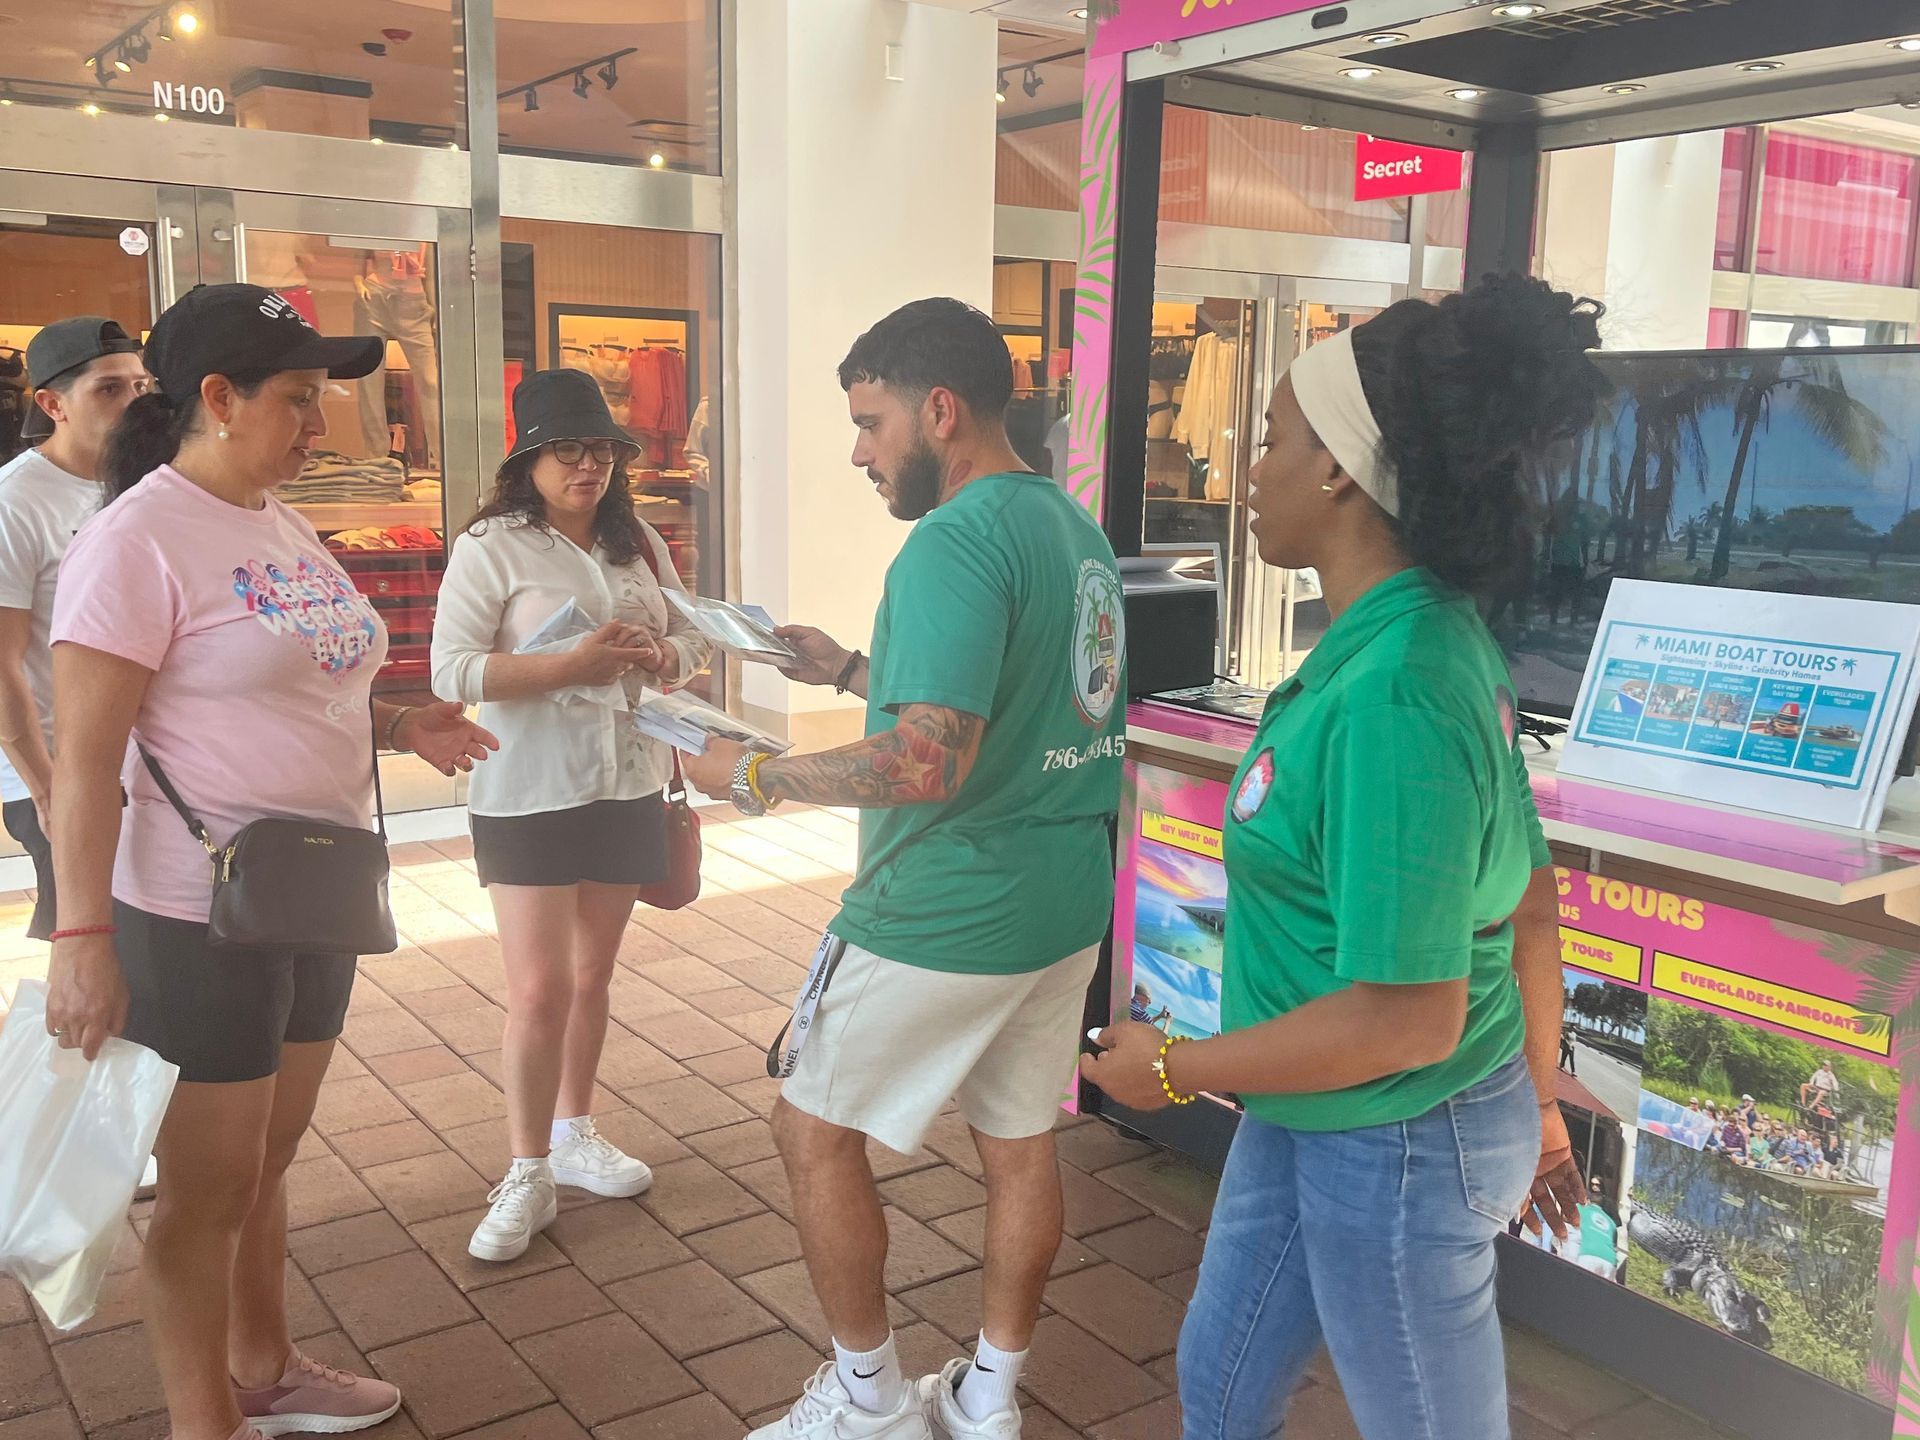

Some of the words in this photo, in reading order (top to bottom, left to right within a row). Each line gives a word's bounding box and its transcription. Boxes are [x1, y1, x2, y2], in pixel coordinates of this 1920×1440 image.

[153, 80, 225, 115] N100
[1362, 155, 1423, 180] Secret
[1653, 636, 1711, 657] MIAMI
[1715, 643, 1768, 663] BOAT
[1772, 649, 1838, 672] TOURS
[1714, 659, 1744, 672] Skyline
[1751, 664, 1791, 679] Celebrity
[1791, 670, 1822, 681] Homes
[1160, 823, 1176, 835] KEY
[1178, 829, 1201, 842] WEST
[1203, 836, 1219, 848] DAY
[1586, 875, 1705, 931] TOURS
[1571, 941, 1614, 963] TOURS
[1680, 971, 1865, 1035] EVERGLADES+AIRBOATS
